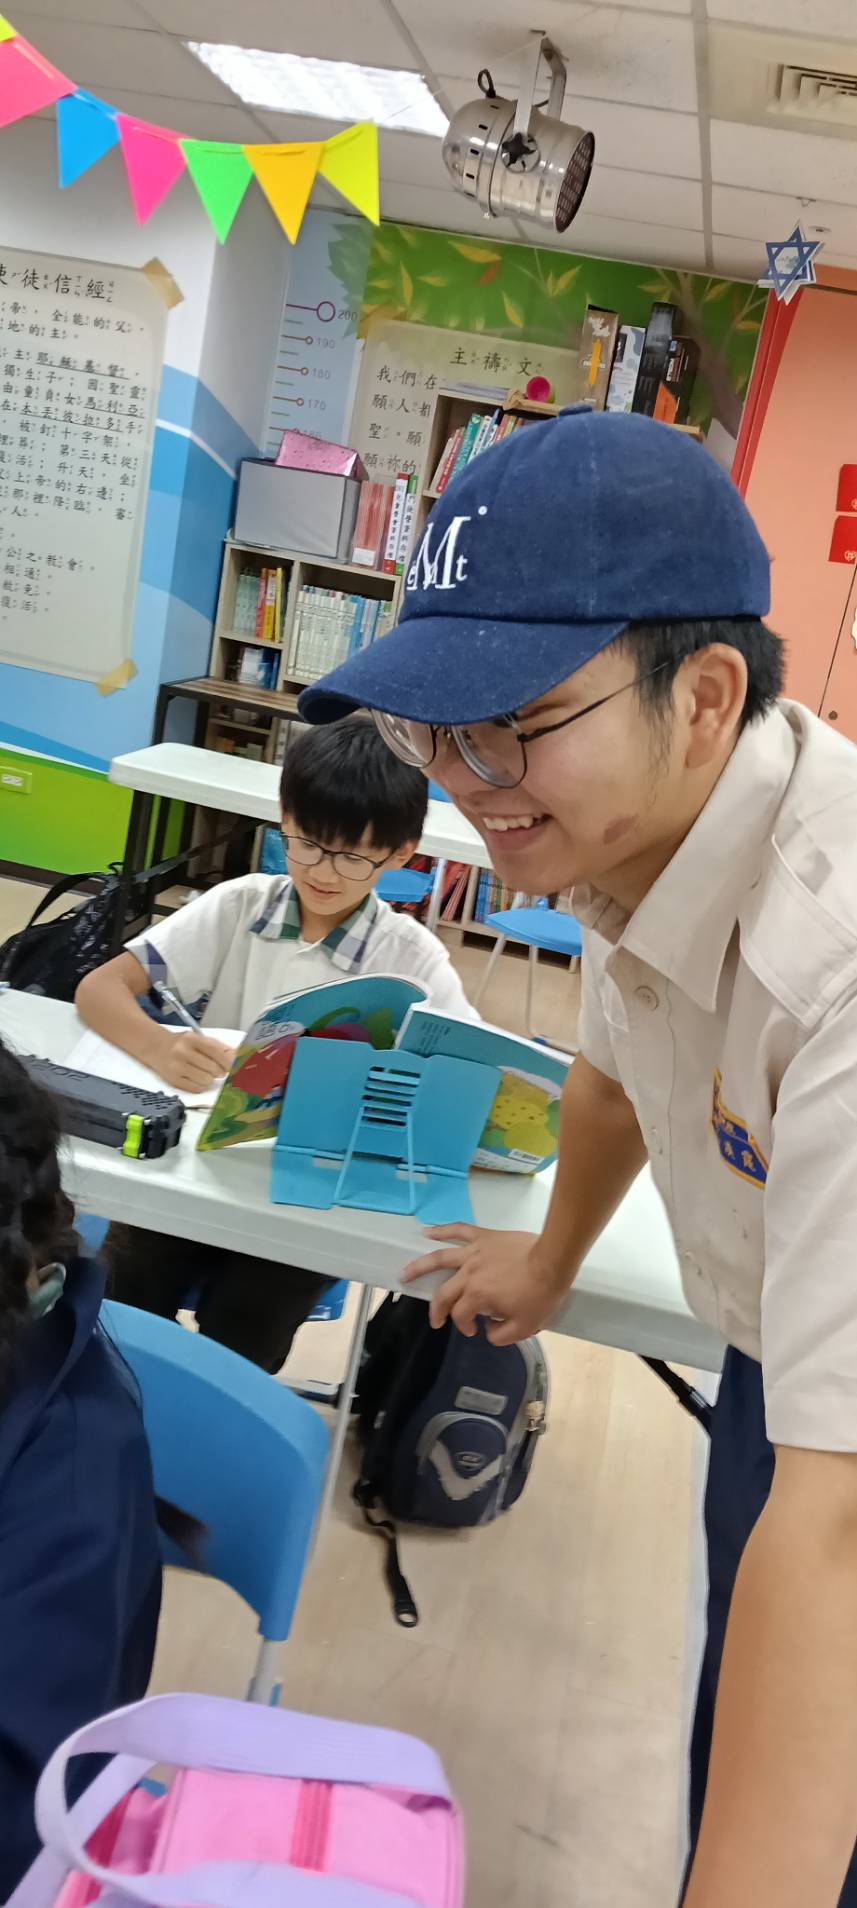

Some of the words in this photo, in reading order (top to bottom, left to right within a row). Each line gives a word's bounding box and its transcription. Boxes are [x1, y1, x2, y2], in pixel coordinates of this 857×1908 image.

[337, 308, 358, 322] 200
[316, 336, 336, 350] 190
[449, 347, 540, 377] 主禱文
[311, 366, 331, 380] 180
[376, 365, 438, 392] 我們在
[307, 398, 327, 411] 170
[371, 393, 431, 418] 願人都
